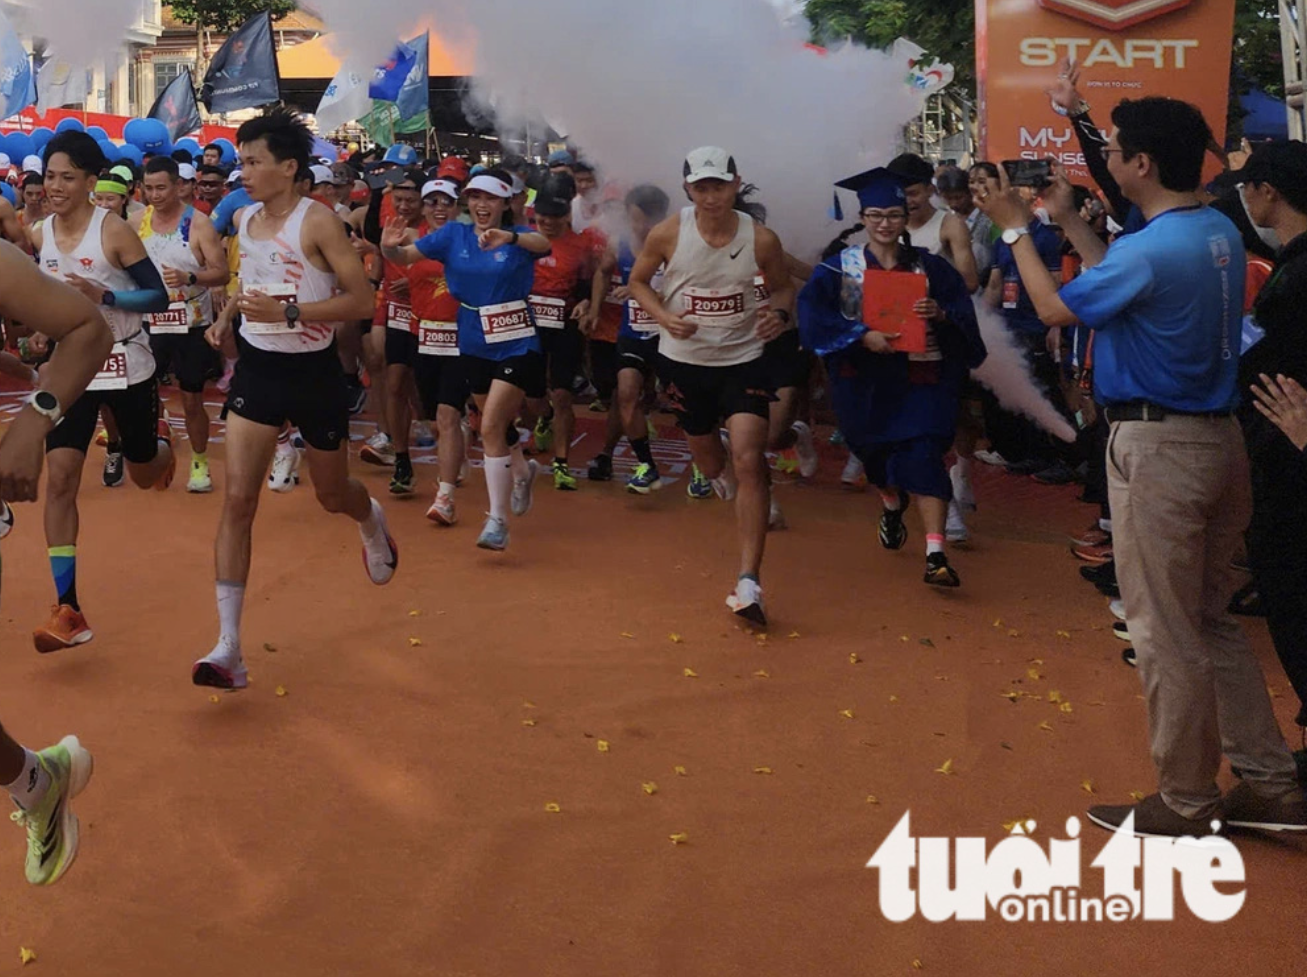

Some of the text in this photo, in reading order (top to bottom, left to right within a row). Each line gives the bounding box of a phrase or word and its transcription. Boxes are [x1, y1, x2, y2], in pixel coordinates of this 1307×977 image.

[1019, 37, 1198, 69] START
[1019, 126, 1071, 148] MY
[694, 299, 735, 310] 20979
[153, 312, 180, 322] 20771
[492, 313, 525, 327] 20687
[426, 331, 456, 342] 20803
